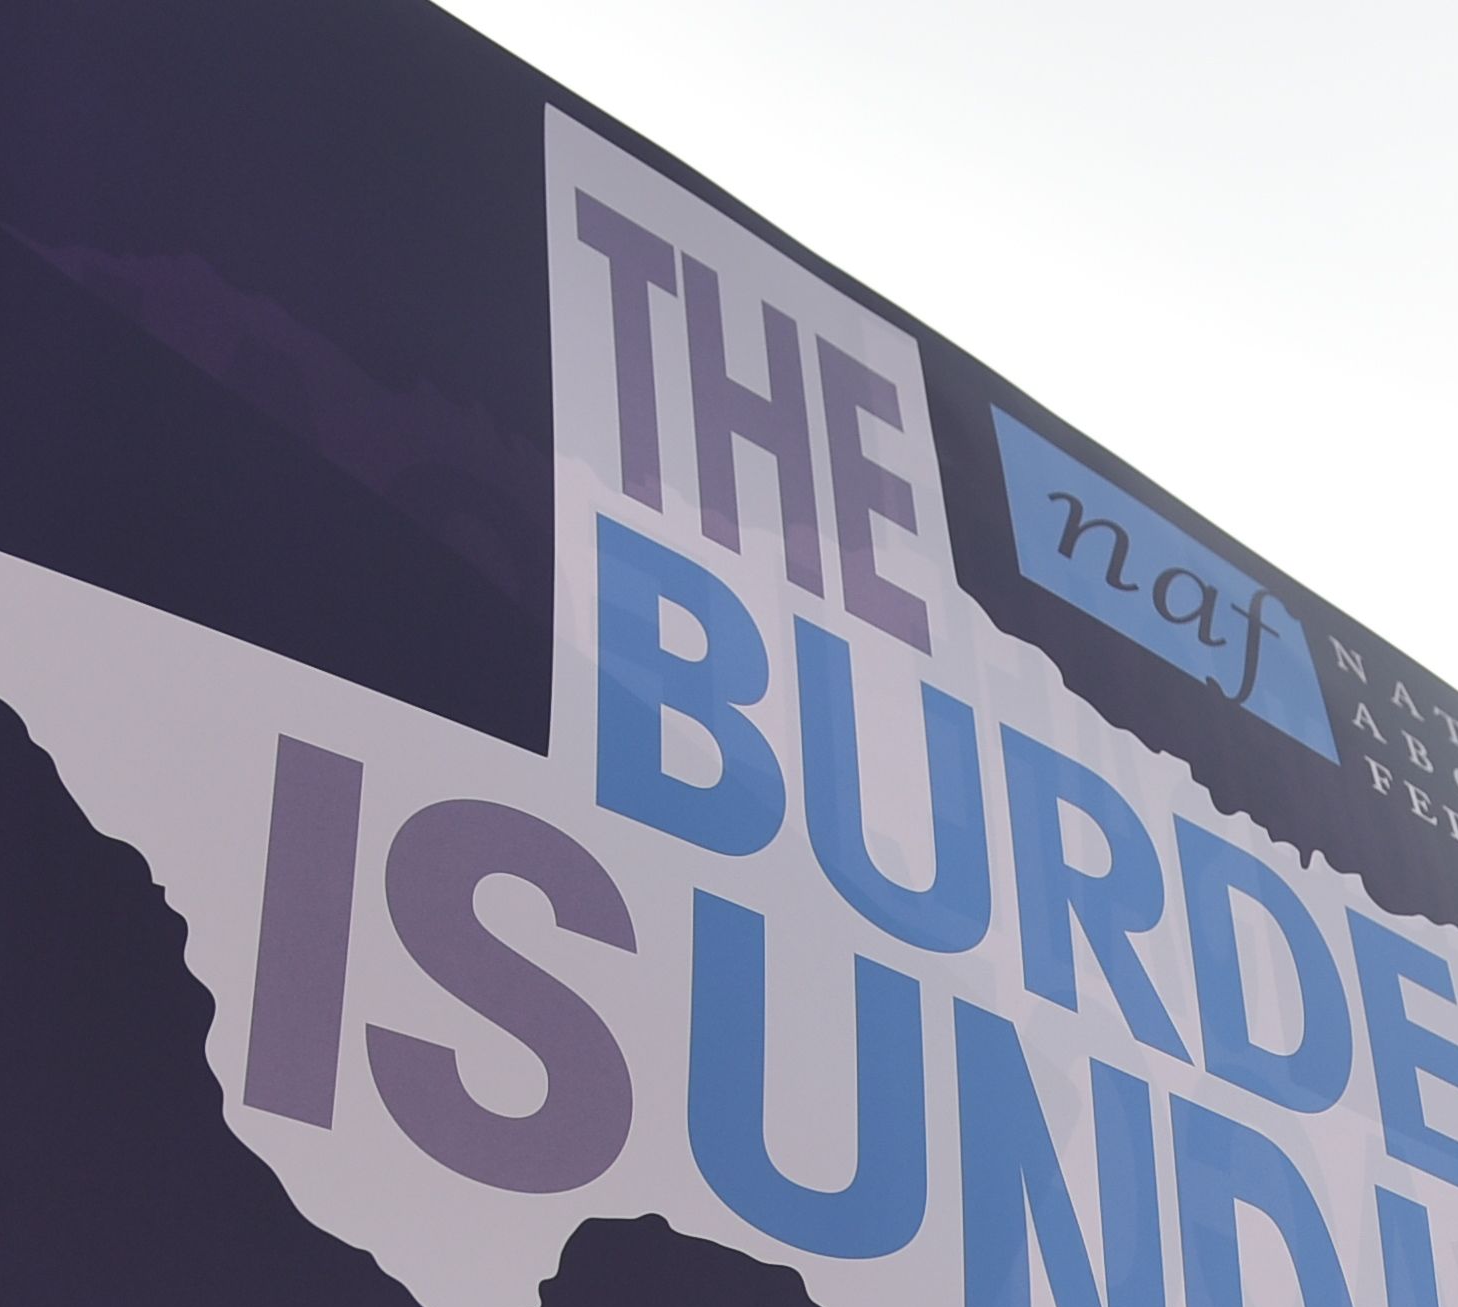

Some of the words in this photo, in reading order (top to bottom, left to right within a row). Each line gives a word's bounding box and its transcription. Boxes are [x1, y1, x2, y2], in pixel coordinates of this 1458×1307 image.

[573, 185, 933, 658] THE
[1047, 490, 1302, 704] naf
[242, 732, 638, 1195] IS
